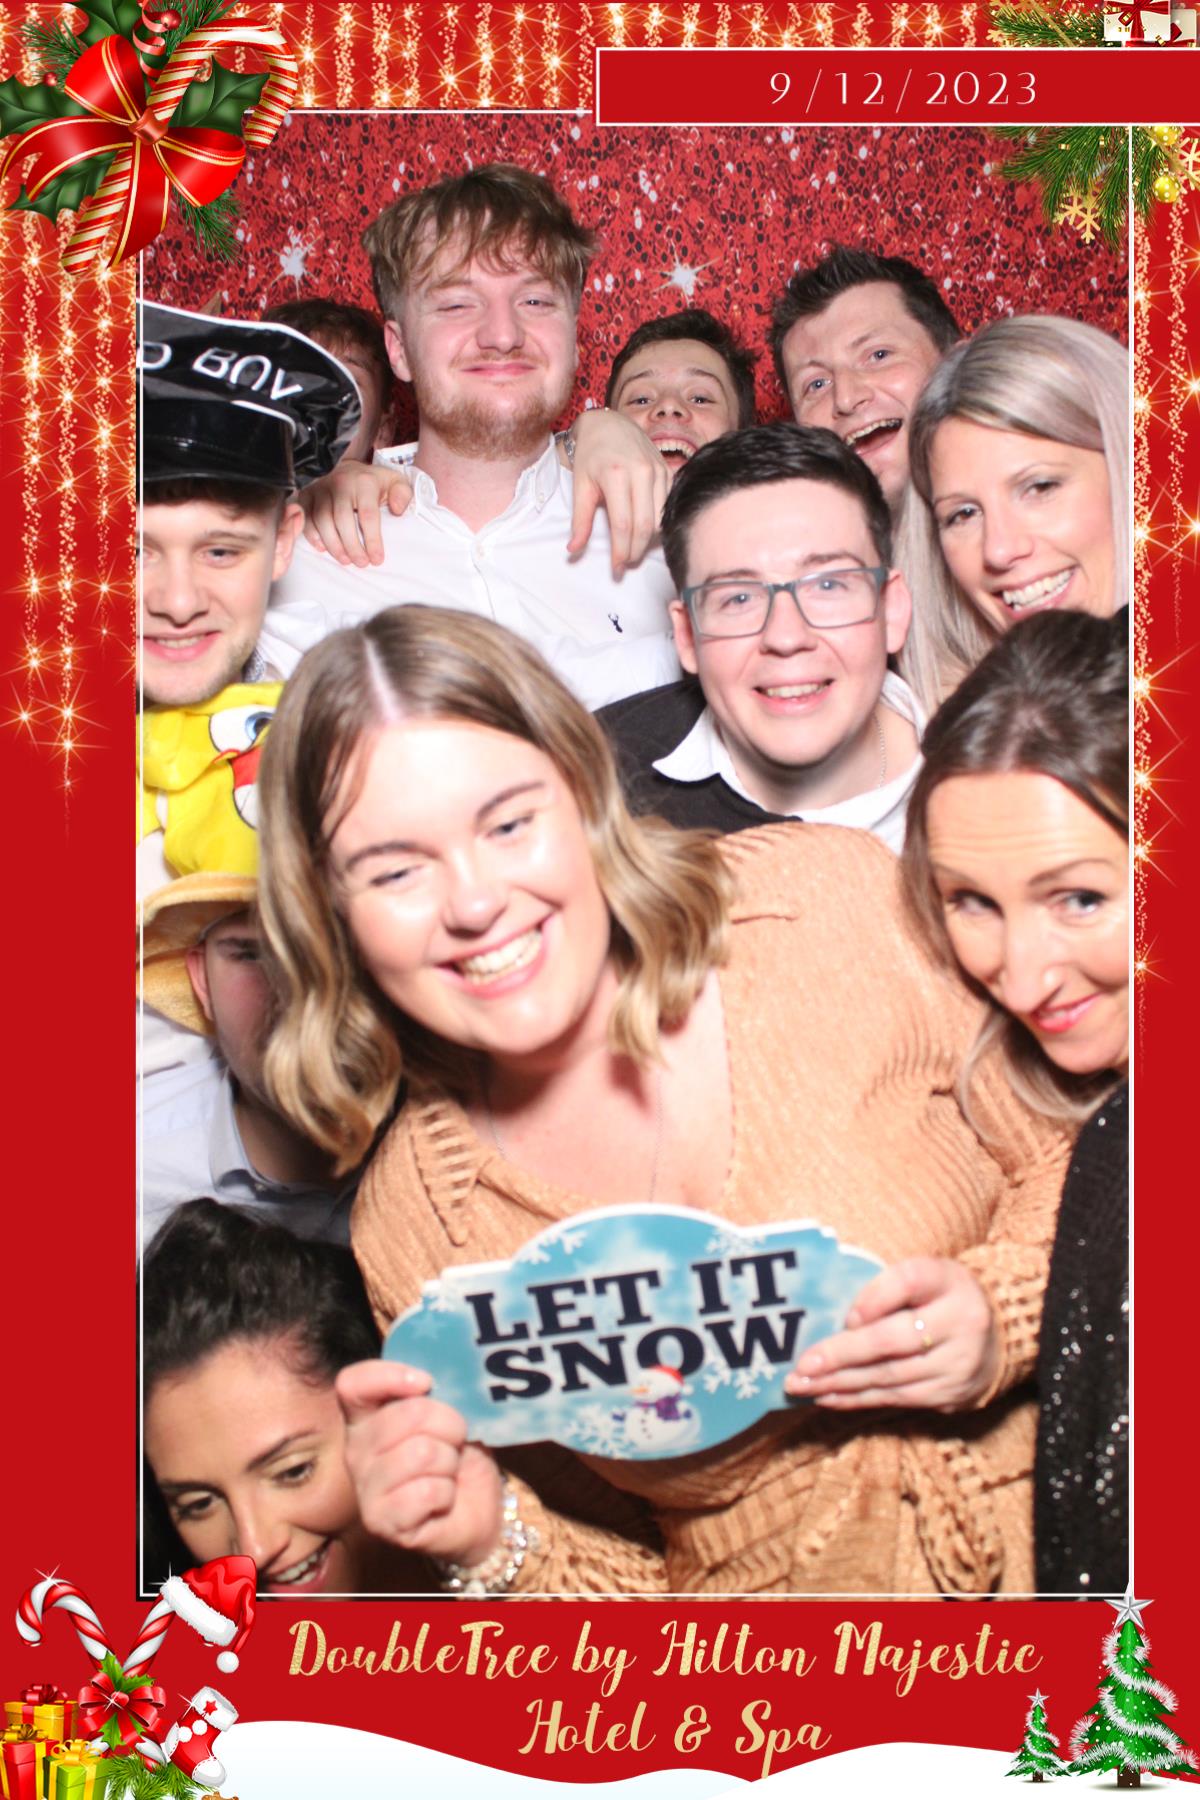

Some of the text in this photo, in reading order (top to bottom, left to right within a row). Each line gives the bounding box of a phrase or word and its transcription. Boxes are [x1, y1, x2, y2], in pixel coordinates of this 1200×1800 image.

[465, 1250, 797, 1346] LET IT
[484, 1310, 806, 1402] SNOW
